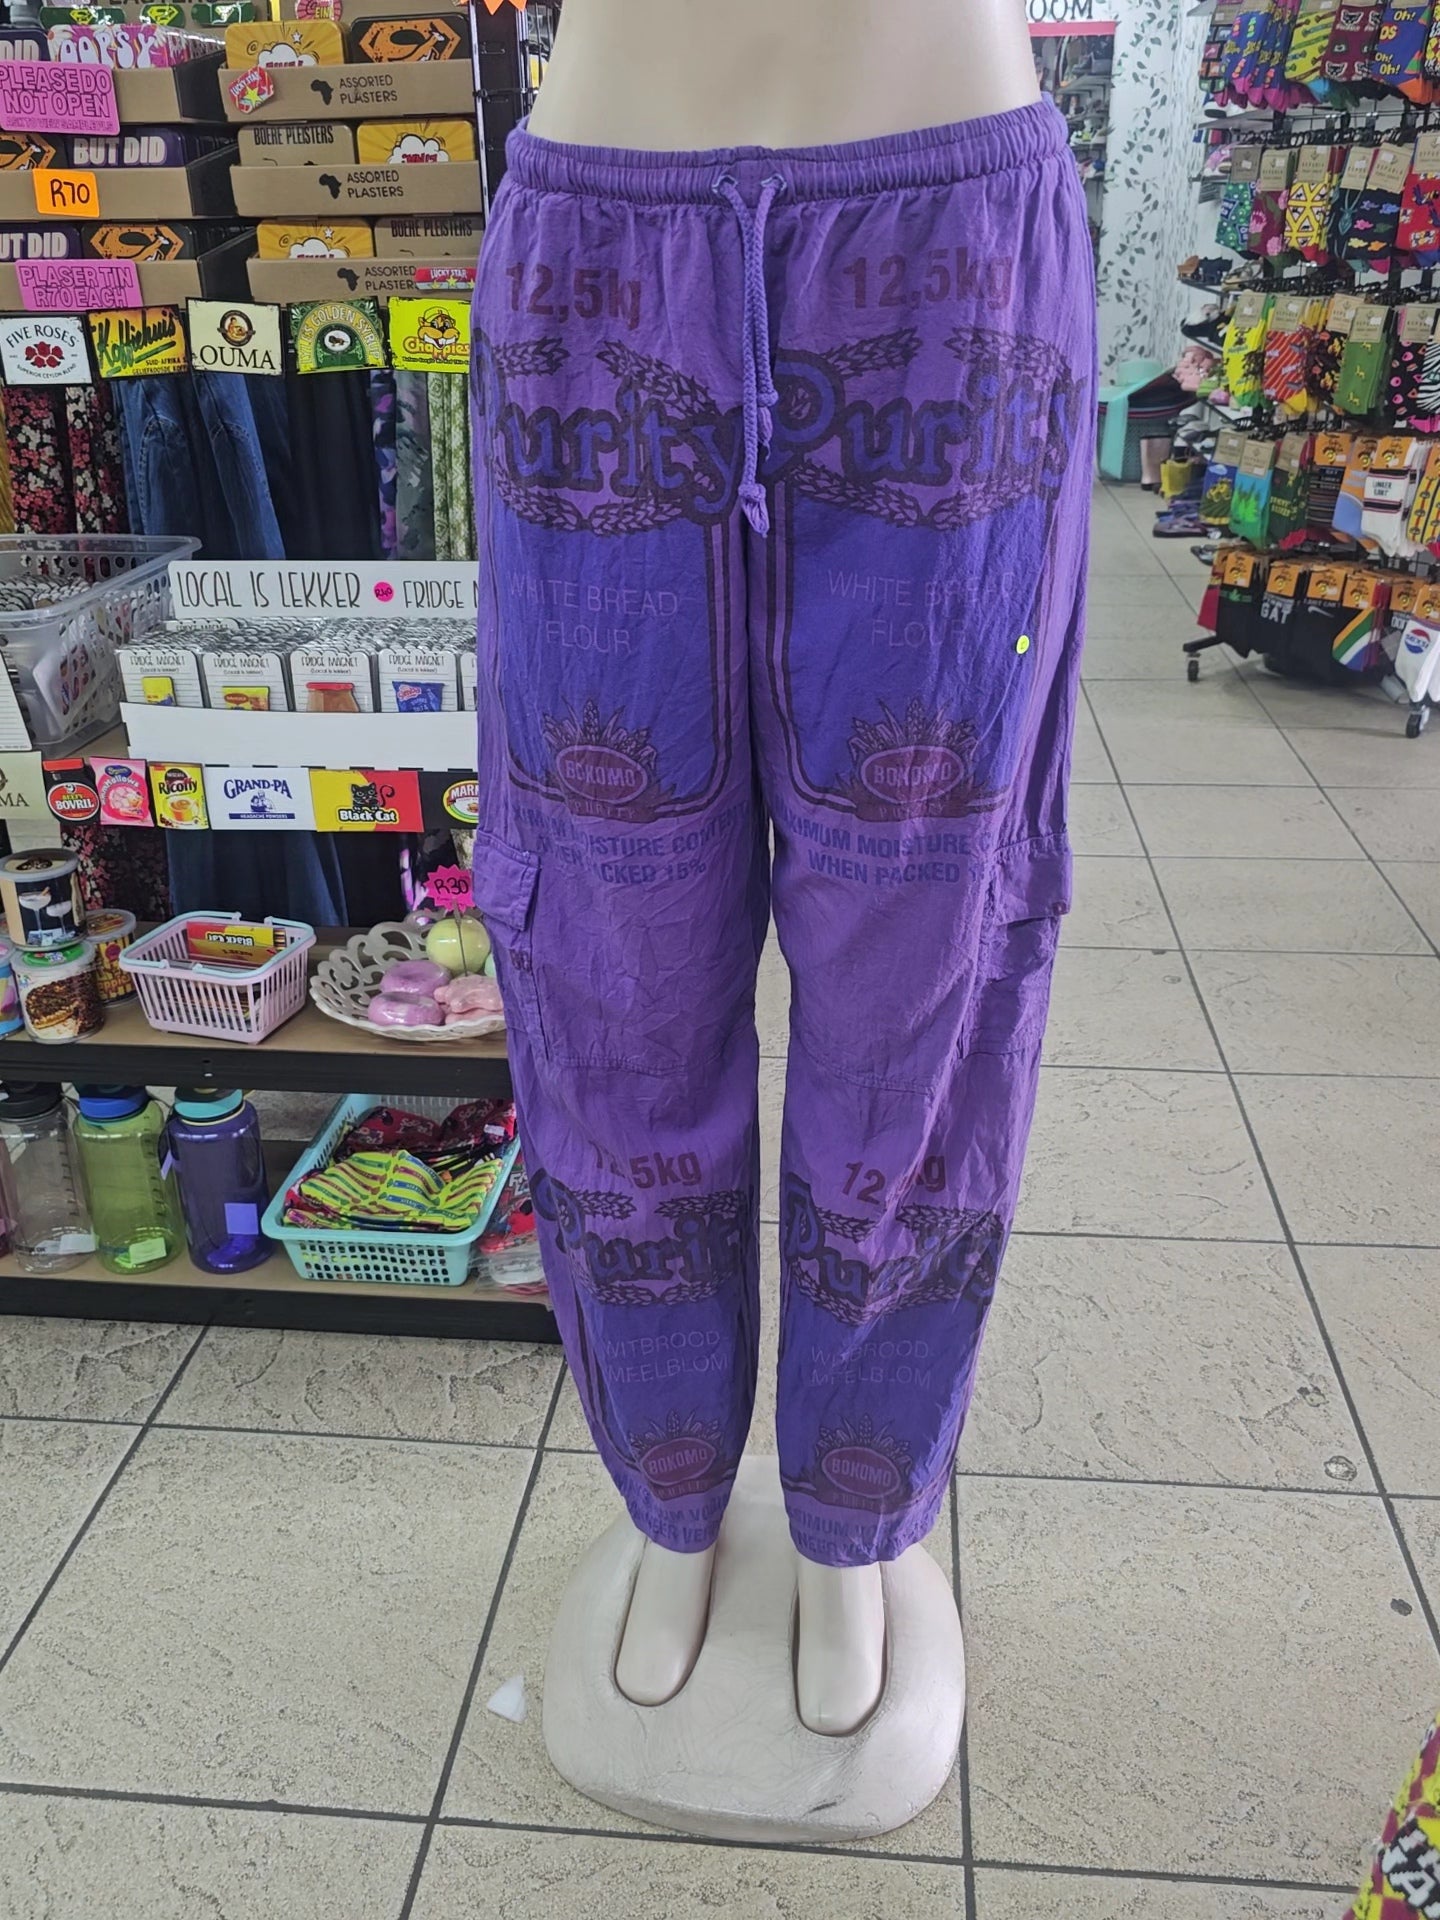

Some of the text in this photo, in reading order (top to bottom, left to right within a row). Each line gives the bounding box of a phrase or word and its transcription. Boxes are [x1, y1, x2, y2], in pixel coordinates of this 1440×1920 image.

[1393, 10, 1416, 20] Oh!
[61, 32, 155, 68] OOPSY
[0, 65, 111, 94] PLEASE DO
[1380, 63, 1400, 74] Oh!
[339, 75, 393, 88] ASSORTED
[4, 89, 111, 117] NOT OPEN
[340, 90, 397, 104] PLASTERS
[254, 125, 334, 145] BOERE PLEISTERS
[73, 136, 166, 165] BUT DID
[347, 170, 399, 184] ASSORTED
[50, 178, 90, 207] R70
[347, 185, 404, 198] PLASTERS
[391, 219, 473, 237] BOERE PLEISTERS
[27, 232, 67, 258] DID
[19, 266, 134, 288] PLASER TIN
[365, 266, 417, 278] ASSORTED
[431, 269, 467, 279] LUCKY STAR
[33, 285, 128, 309] R70 EACH
[365, 280, 419, 291] PLASTER
[6, 324, 77, 348] FIVE ROSES
[97, 309, 177, 370] Koffiehuis
[312, 305, 355, 327] GOLDEN
[358, 318, 381, 359] SYRUP
[200, 344, 276, 370] OUMA
[402, 336, 470, 360] Chappies
[176, 571, 361, 608] LOCAL IS LEKKER
[403, 580, 466, 609] FRIDGE
[587, 584, 678, 617] BREAD
[827, 570, 912, 607] WHITE
[546, 620, 632, 655] FLOUR
[564, 758, 637, 788] BOKOMO
[158, 778, 198, 795] Ricoffy
[223, 779, 292, 799] GRAND-PA
[55, 798, 95, 810] BOVRIL
[339, 809, 397, 823] Black Cat
[808, 849, 961, 887] WHEN PACKED
[434, 877, 469, 895] R30
[648, 1447, 709, 1475] BOKOMO
[831, 1457, 892, 1488] BOKOMO
